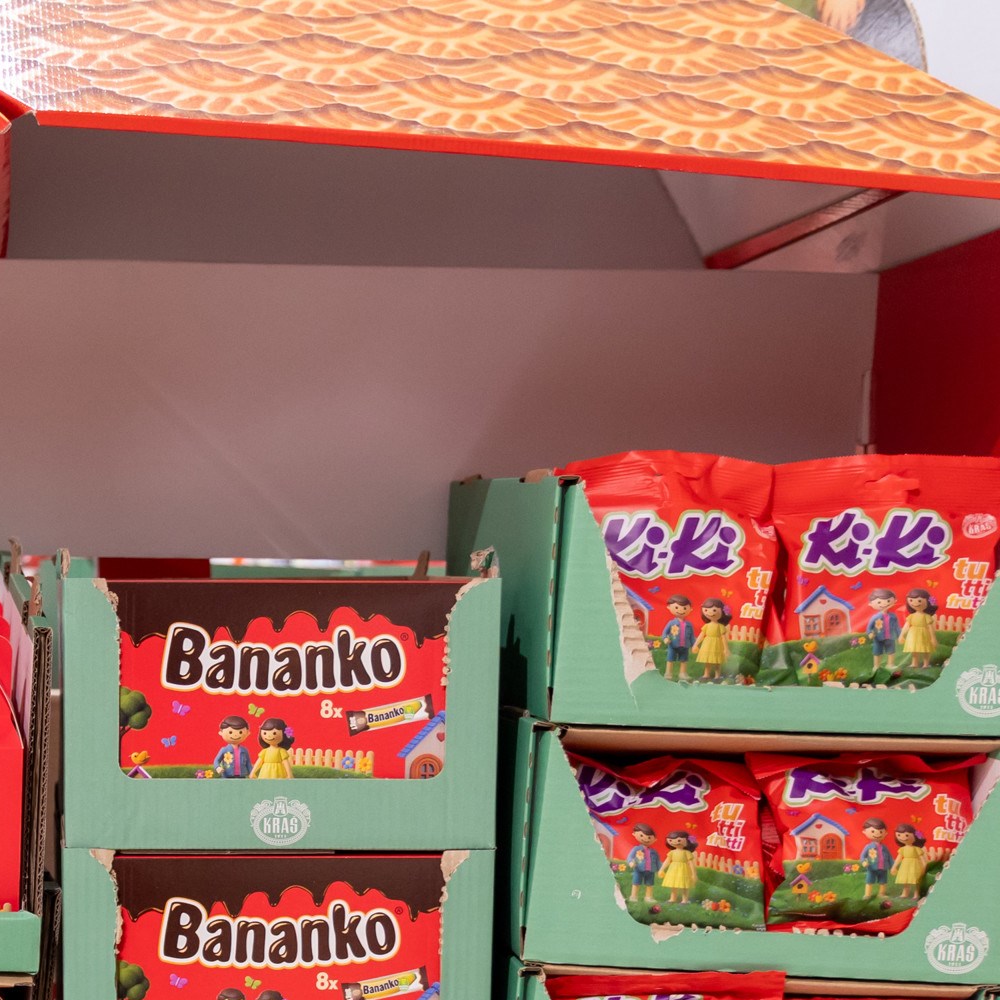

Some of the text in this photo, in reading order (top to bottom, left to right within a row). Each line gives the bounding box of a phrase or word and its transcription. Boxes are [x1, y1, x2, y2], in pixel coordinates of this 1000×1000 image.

[603, 514, 738, 576] Ki-Ki
[803, 510, 947, 571] Ki-Ki
[953, 558, 990, 580] tu
[163, 624, 403, 694] Bananko
[320, 699, 343, 719] 8x
[367, 706, 404, 723] Bananko
[710, 801, 744, 822] tu
[717, 820, 745, 837] tti
[162, 899, 398, 965] Bananko
[315, 972, 339, 991] 8x
[363, 978, 399, 995] Bananko
